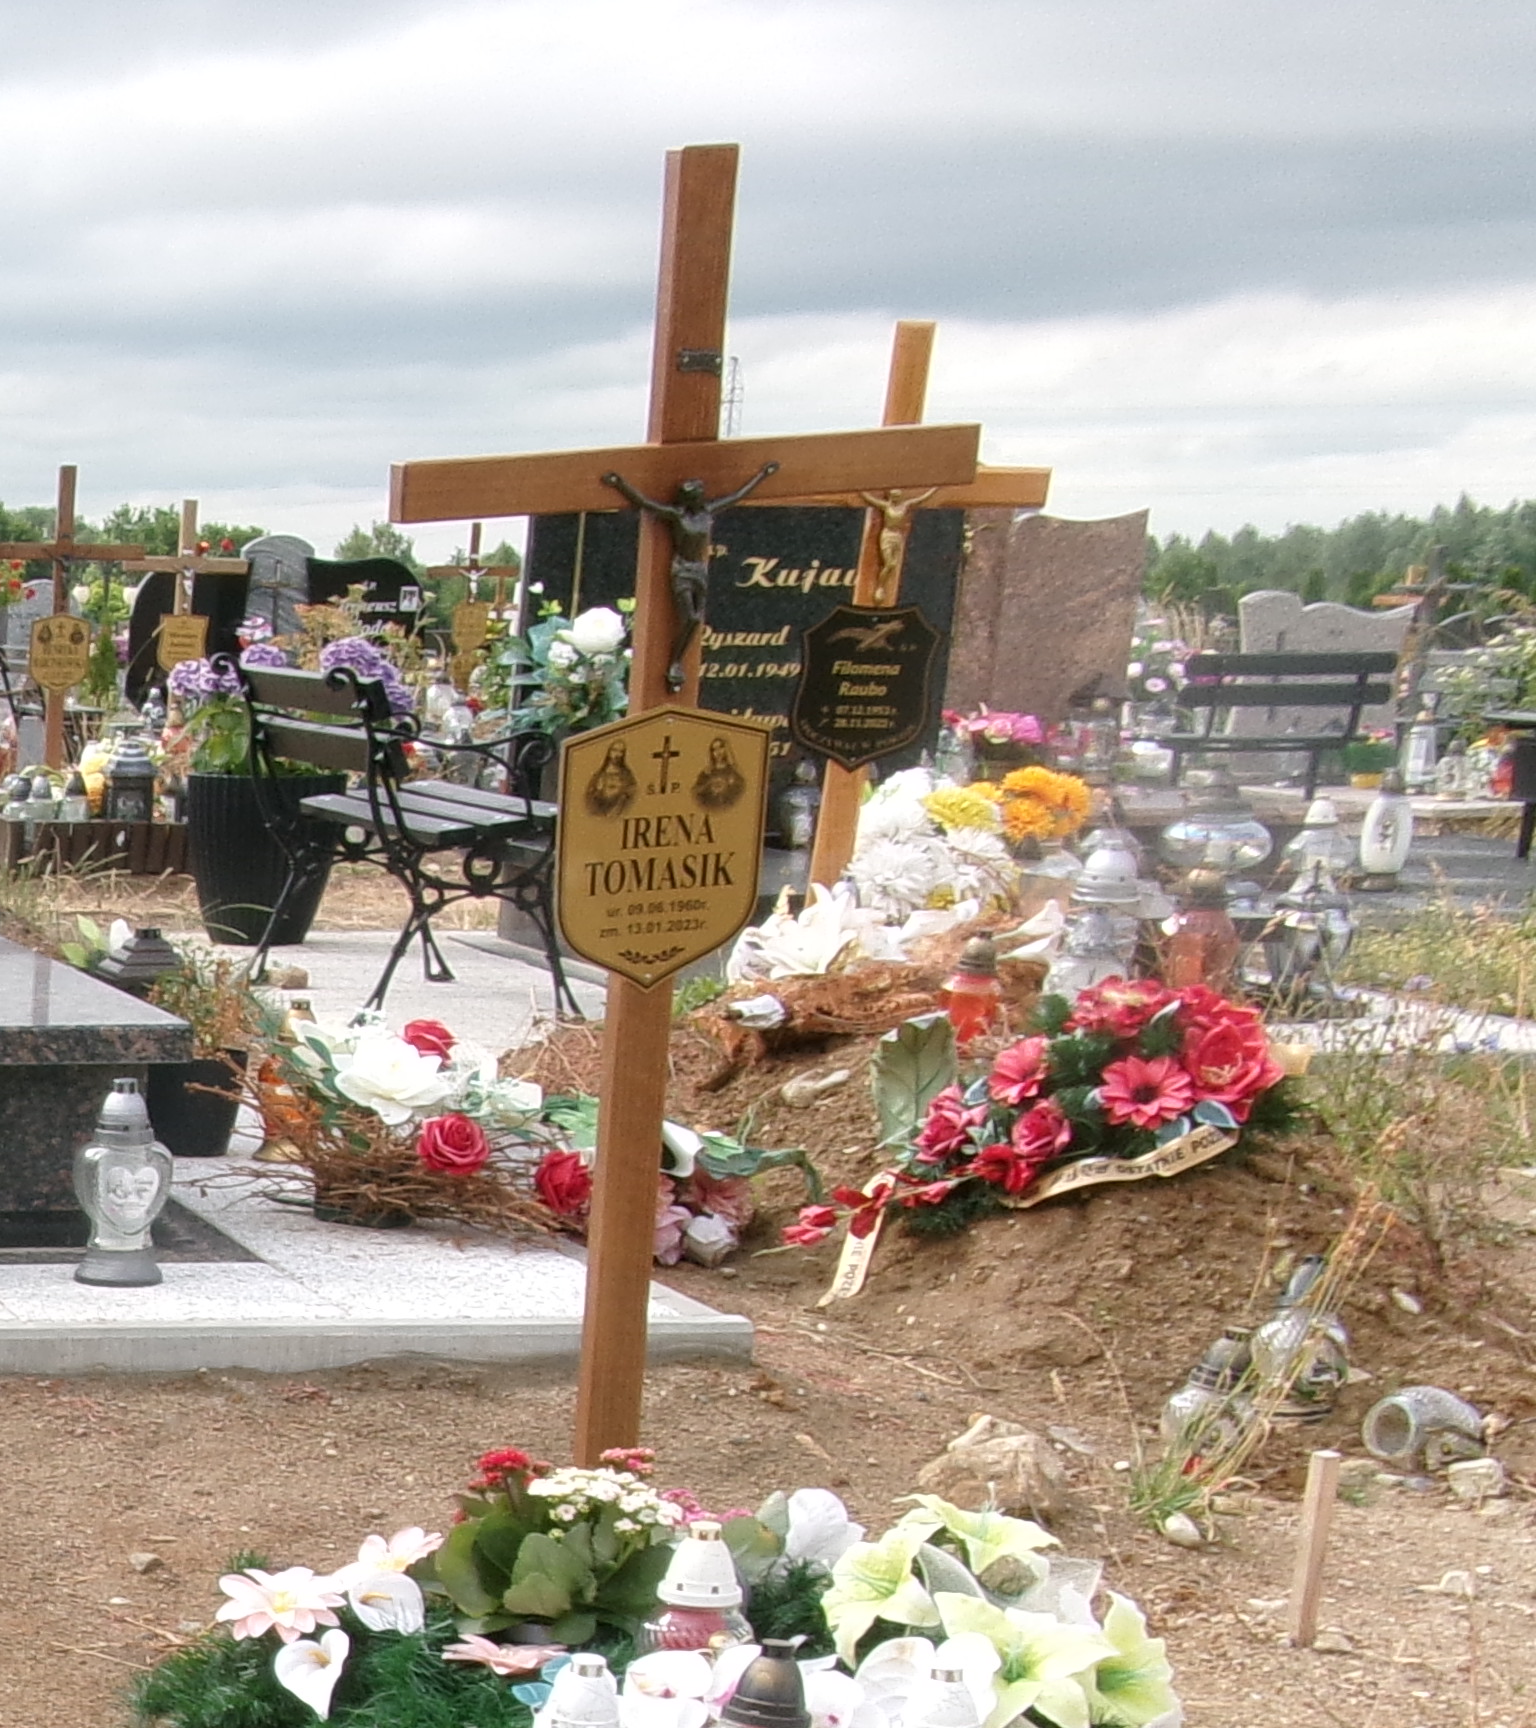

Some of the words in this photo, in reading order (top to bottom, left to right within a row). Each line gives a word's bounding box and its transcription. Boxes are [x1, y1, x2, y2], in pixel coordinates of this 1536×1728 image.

[831, 660, 902, 675] Filomena
[838, 681, 888, 696] Raubo
[621, 813, 715, 850] IRENA
[584, 852, 736, 897] TOMASIK
